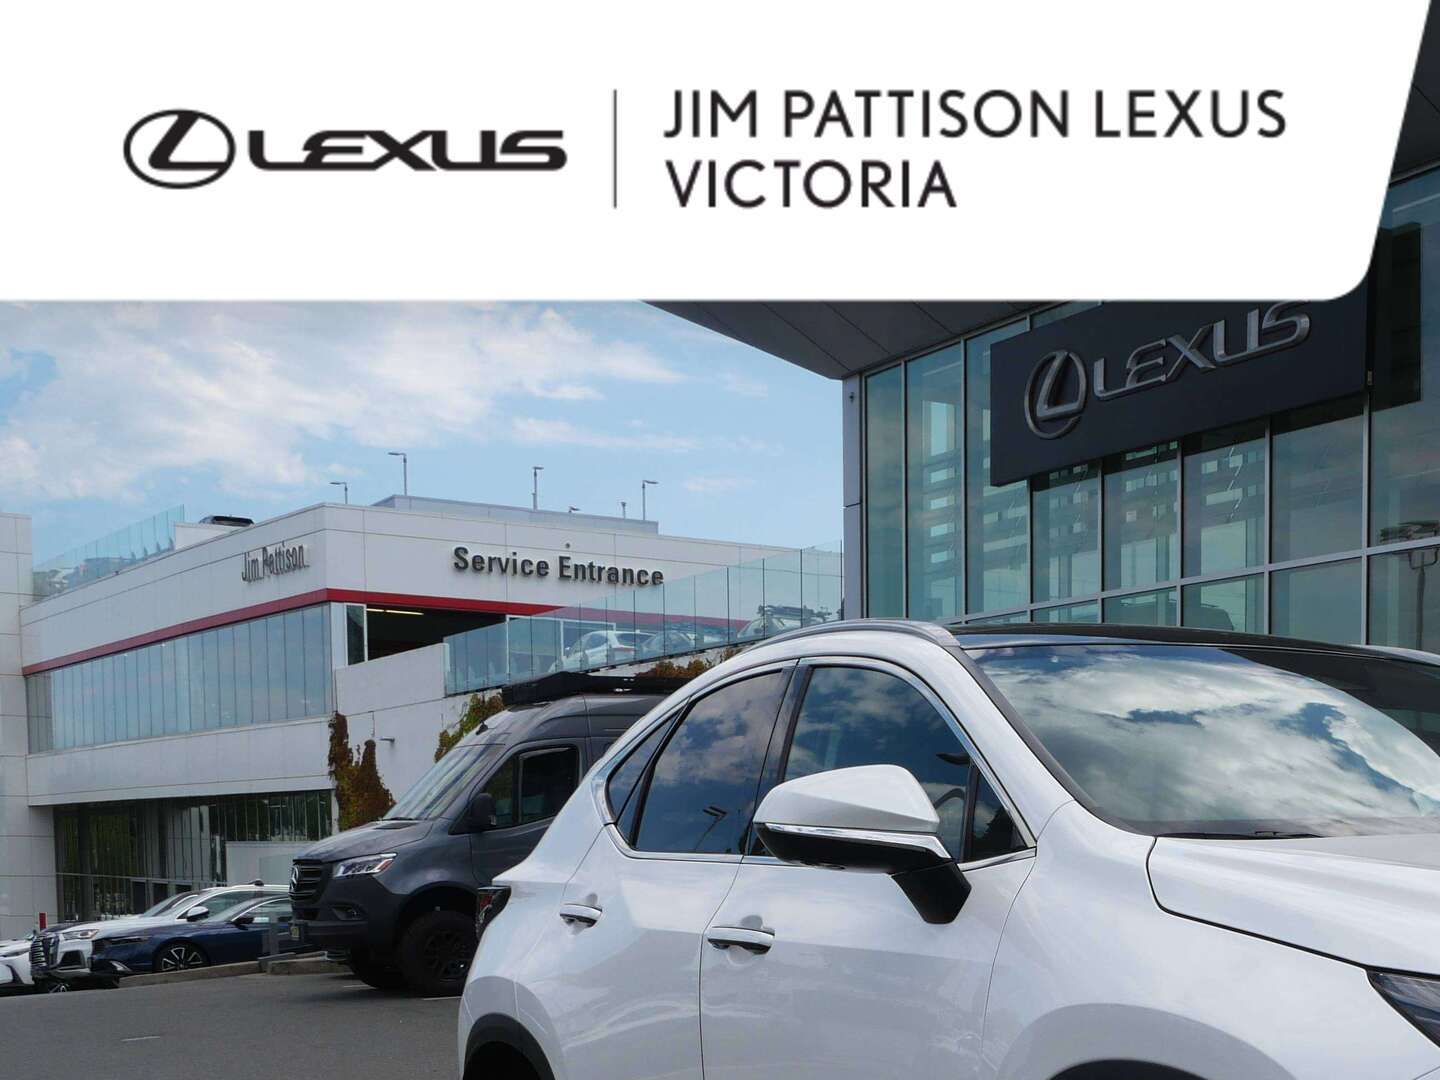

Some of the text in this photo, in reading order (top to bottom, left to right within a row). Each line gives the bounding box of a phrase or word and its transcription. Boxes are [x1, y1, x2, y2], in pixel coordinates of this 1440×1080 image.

[1093, 300, 1310, 398] LEXUS
[242, 540, 305, 582] Jim Pattison
[453, 546, 665, 587] Service Entrance
